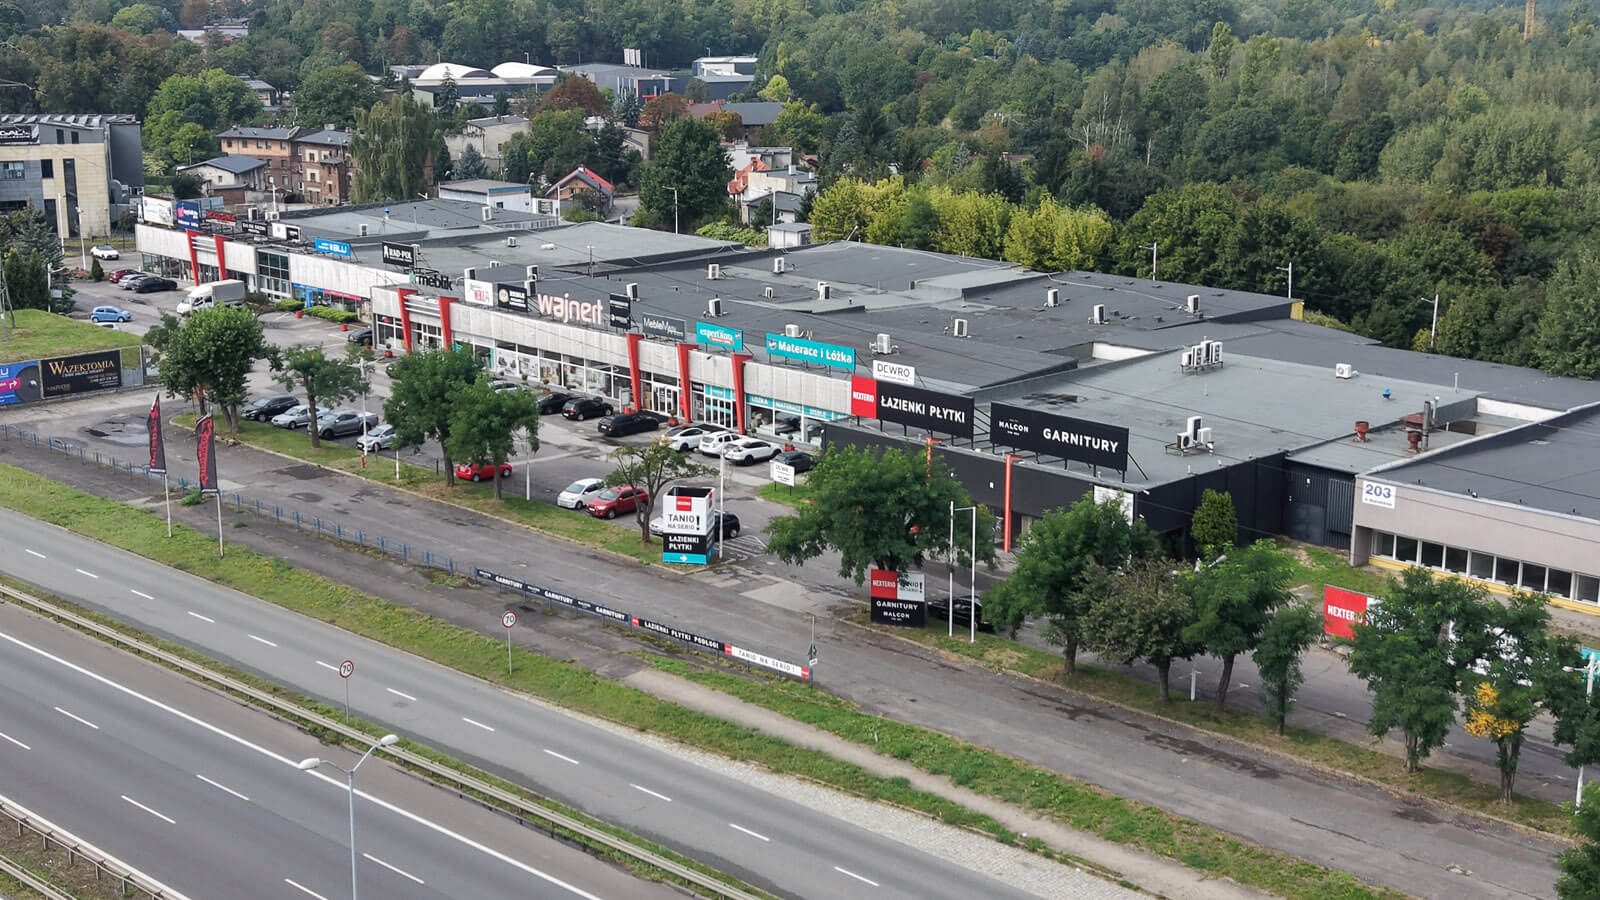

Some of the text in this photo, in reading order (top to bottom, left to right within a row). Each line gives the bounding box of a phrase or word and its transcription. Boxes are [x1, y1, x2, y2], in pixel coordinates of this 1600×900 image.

[417, 275, 453, 291] meblik
[537, 293, 603, 325] wajnert
[778, 340, 818, 358] Materace
[826, 350, 853, 364] Łóżka
[877, 363, 911, 378] DEWRO
[852, 391, 875, 402] NEXTERIO
[880, 394, 965, 424] ŁAZIENKI PŁYTKI
[998, 420, 1029, 433] MALCON
[1042, 428, 1119, 453] GARNITURY
[1365, 483, 1391, 498] 203
[668, 513, 695, 523] TANIO
[668, 535, 700, 544] ŁAZIENKI
[668, 543, 693, 551] PŁYTKI
[876, 600, 918, 610] GARNITURY
[505, 615, 514, 624] 70
[342, 664, 351, 674] 70
